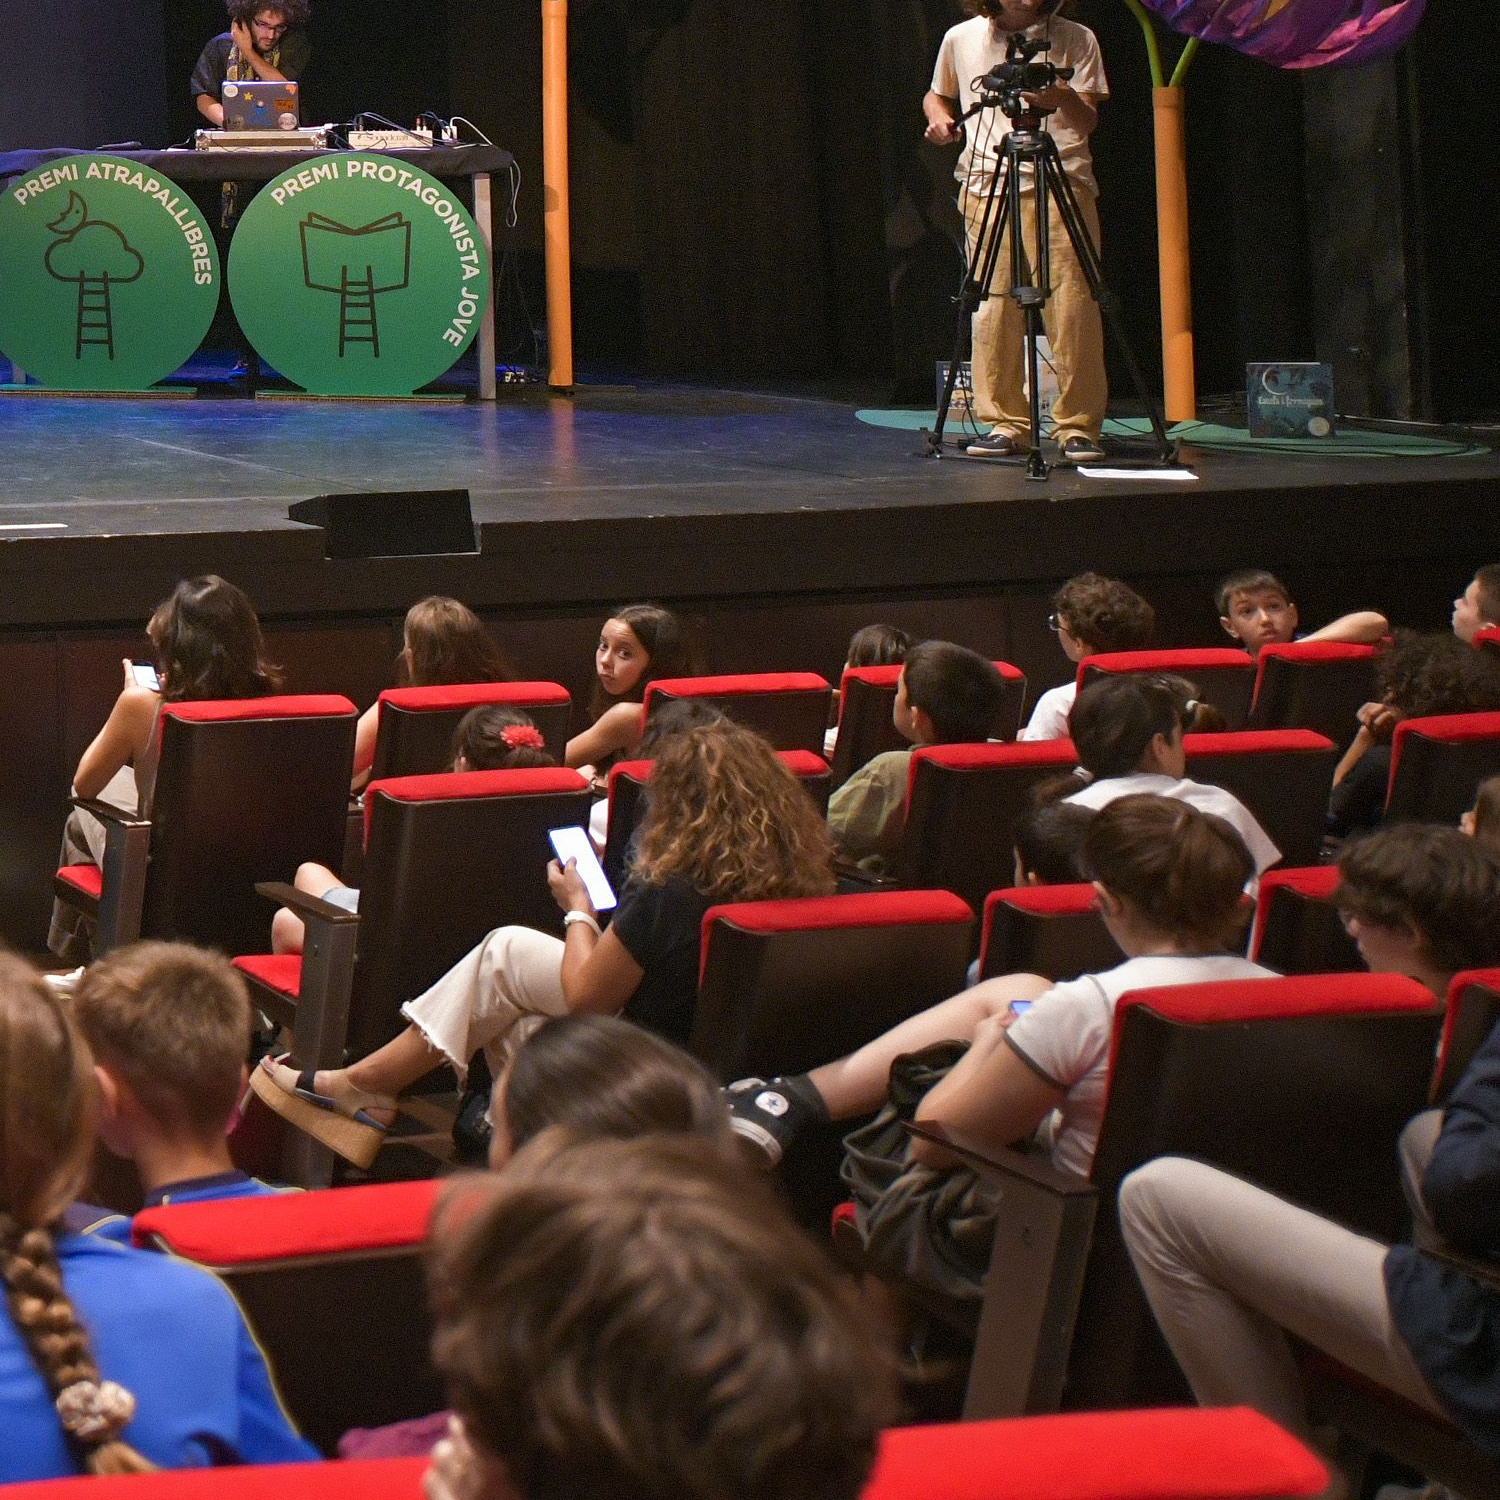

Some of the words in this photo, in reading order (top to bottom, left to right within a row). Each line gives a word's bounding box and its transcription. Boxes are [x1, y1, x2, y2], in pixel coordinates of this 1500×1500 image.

[13, 163, 78, 205] PREMI
[85, 162, 212, 285] ATRAPALLIBRES
[270, 162, 339, 206] PREMI
[347, 160, 480, 281] PROTAGONISTA
[442, 286, 479, 347] JOVE
